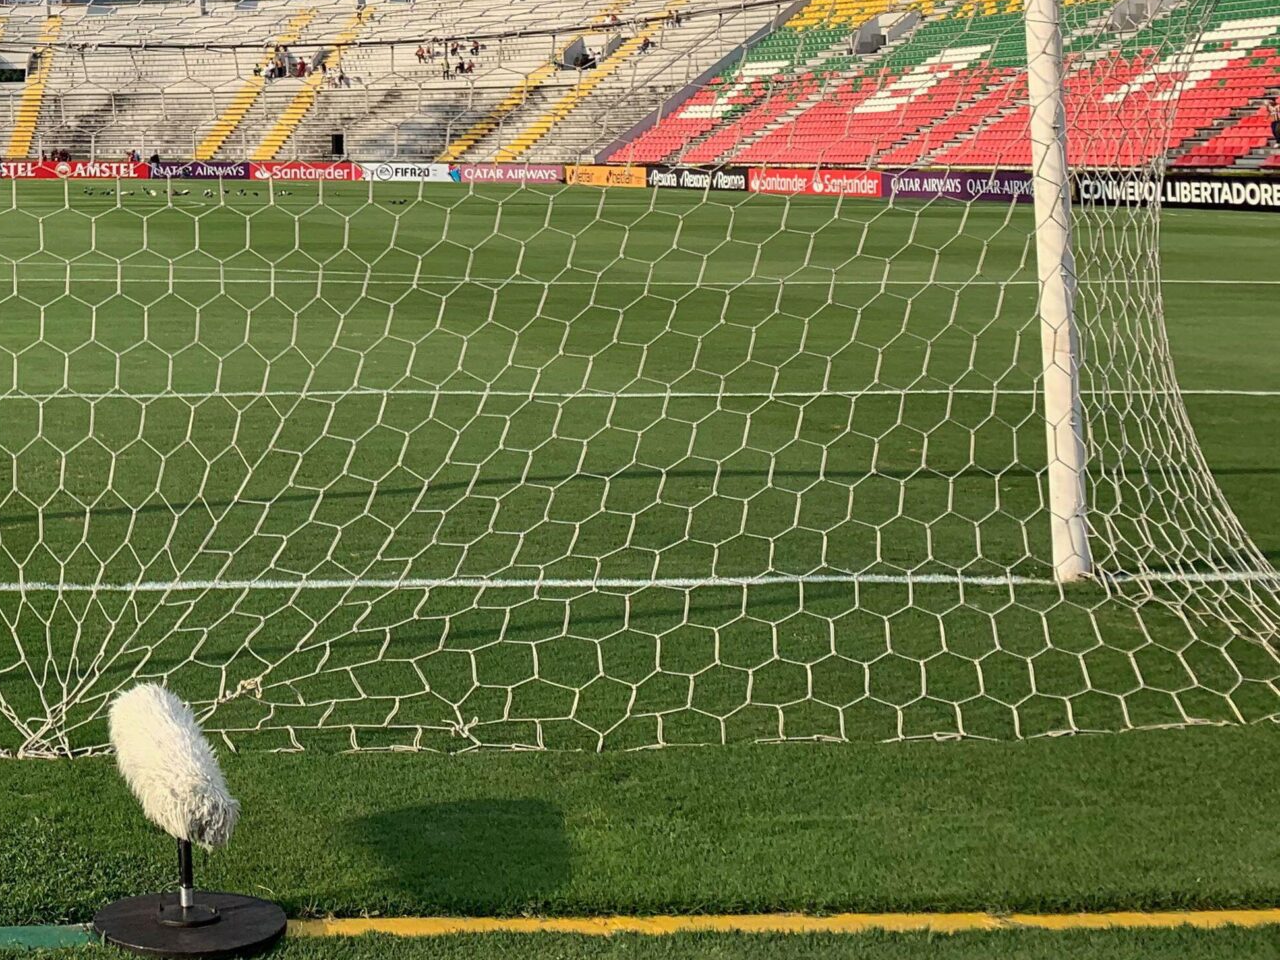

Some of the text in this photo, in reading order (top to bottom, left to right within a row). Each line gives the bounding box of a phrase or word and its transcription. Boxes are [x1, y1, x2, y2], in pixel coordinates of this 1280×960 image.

[73, 162, 138, 177] AMSTEL
[195, 166, 245, 176] AIRWAYS
[272, 165, 350, 179] Santander
[464, 168, 557, 180] QATAR AIRWAYS
[824, 174, 879, 194] Santander
[891, 178, 962, 194] QATAR AIRWAYS
[966, 178, 1001, 196] QATAR
